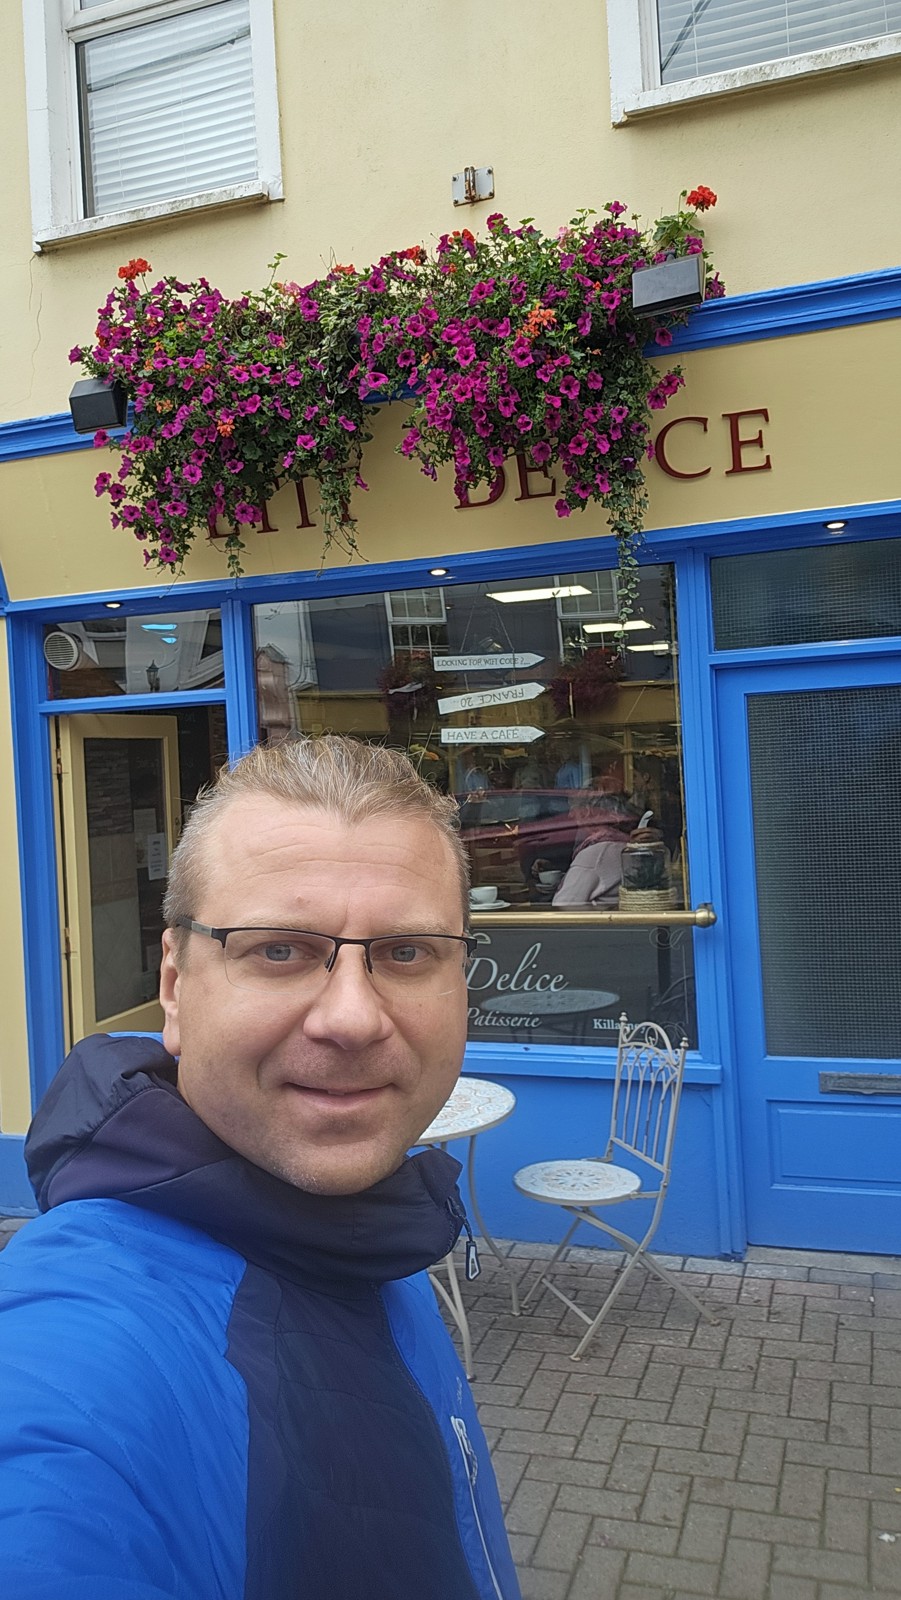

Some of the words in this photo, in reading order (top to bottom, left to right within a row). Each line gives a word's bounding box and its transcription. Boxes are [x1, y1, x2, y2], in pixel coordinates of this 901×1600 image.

[437, 659, 467, 667] LOOKING
[469, 658, 482, 666] FOR
[477, 688, 524, 705] FRANCE
[447, 731, 477, 740] HAVE
[480, 731, 489, 740] A
[466, 942, 569, 992] Delice
[467, 1007, 542, 1028] Patisserie
